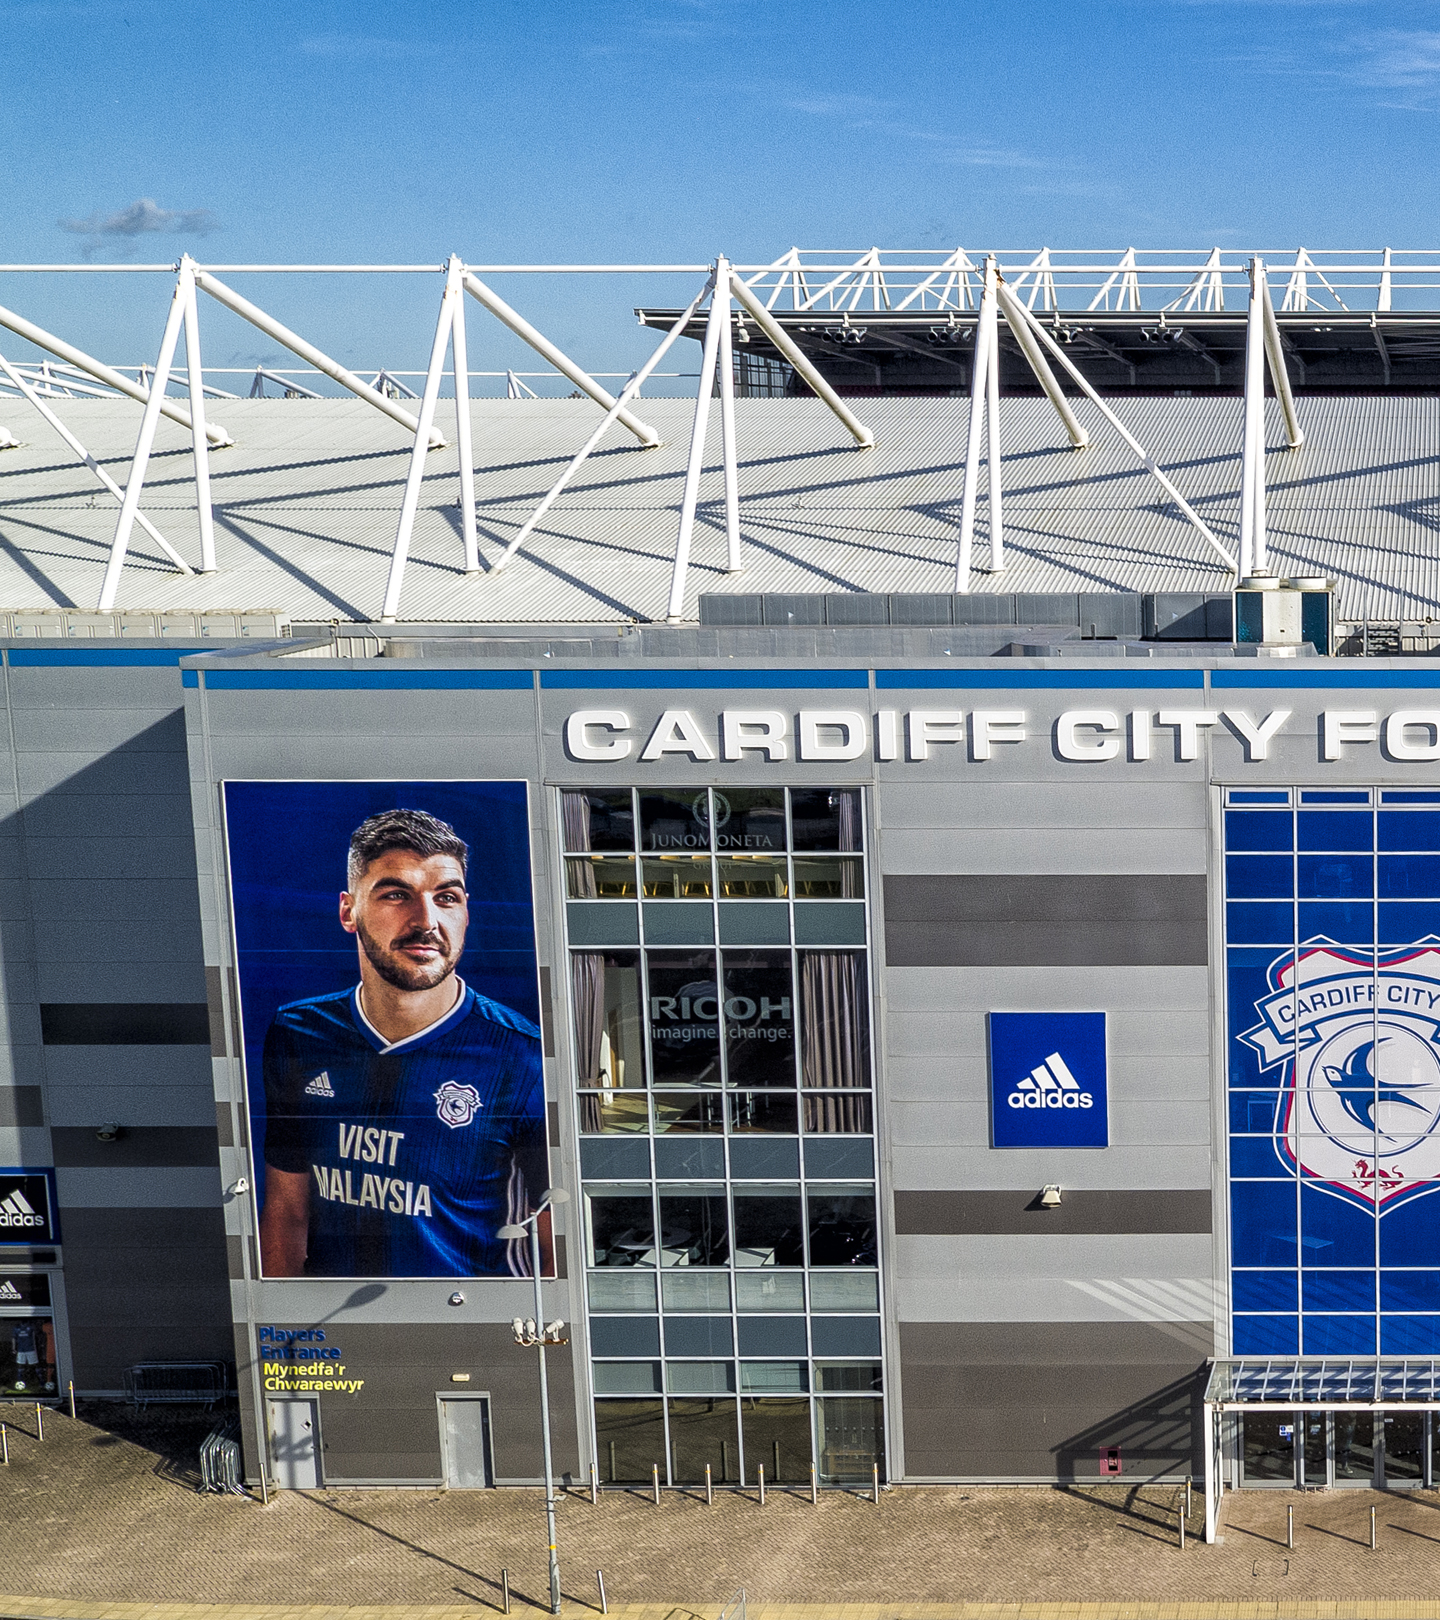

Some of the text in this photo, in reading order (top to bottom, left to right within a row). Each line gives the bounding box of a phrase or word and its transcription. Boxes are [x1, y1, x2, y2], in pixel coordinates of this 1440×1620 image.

[566, 709, 1026, 761] CARDIFF
[1056, 709, 1293, 761] CITY
[692, 862, 734, 870] GRUP
[651, 996, 791, 1020] RICOH
[1277, 984, 1380, 1024] CARDIFF
[652, 1024, 792, 1042] imagine. change.
[304, 1086, 335, 1098] adidas
[1007, 1088, 1094, 1108] adidas
[339, 1122, 405, 1167] VISIT
[0, 1212, 45, 1226] didas
[259, 1325, 327, 1345] Players
[260, 1344, 342, 1360] Entrance
[263, 1361, 346, 1379] Mynedfa'r
[264, 1376, 365, 1394] Chwaraewyr
